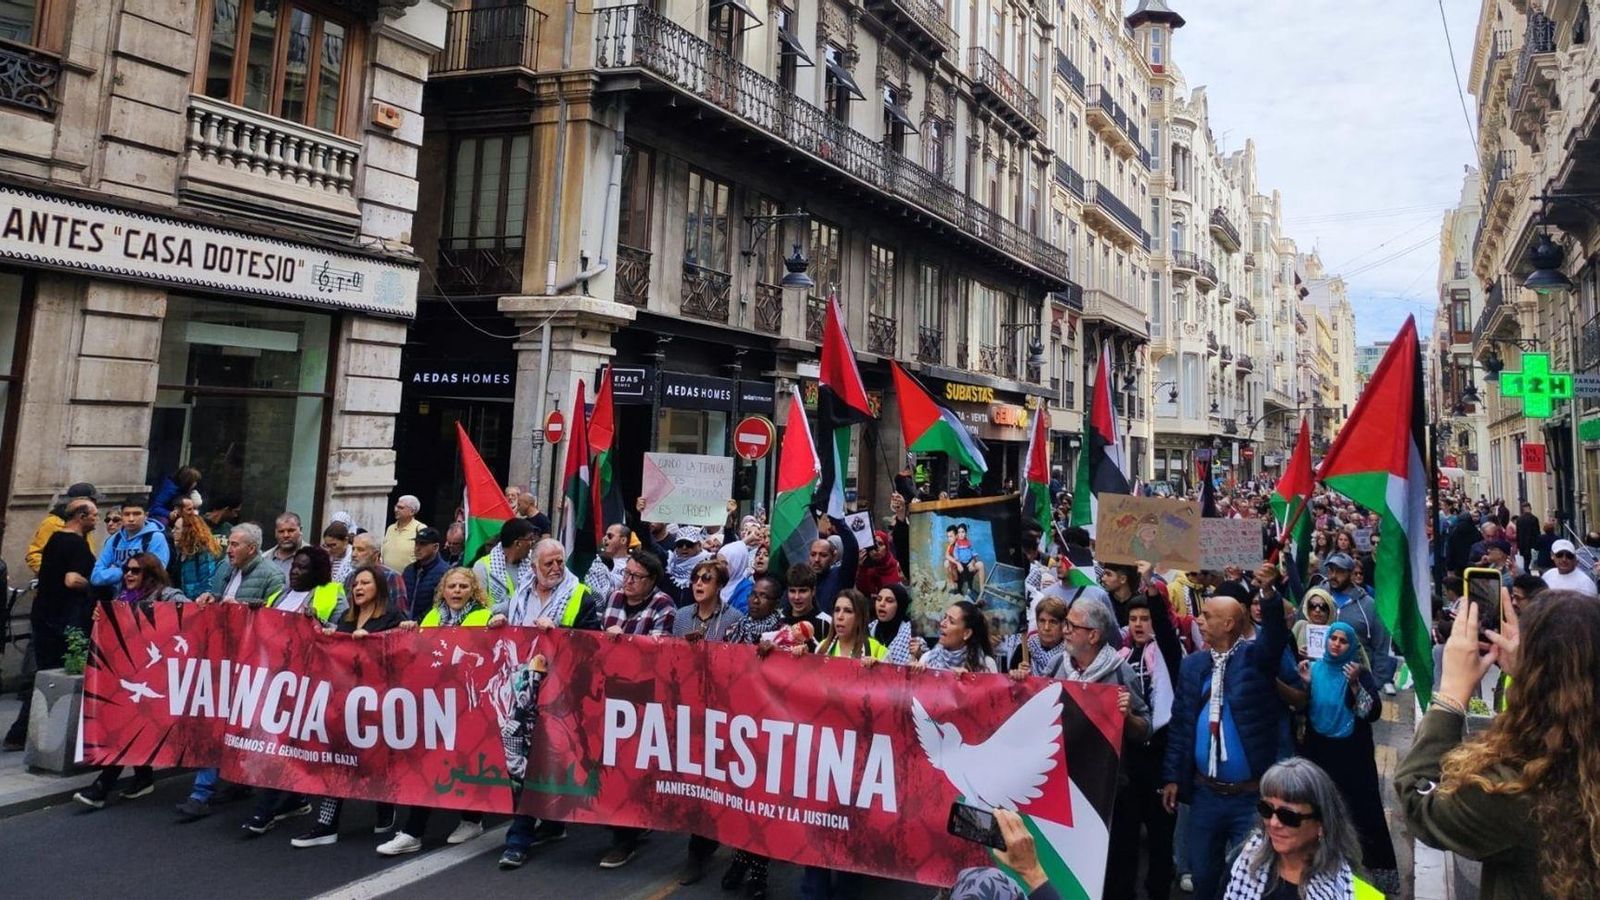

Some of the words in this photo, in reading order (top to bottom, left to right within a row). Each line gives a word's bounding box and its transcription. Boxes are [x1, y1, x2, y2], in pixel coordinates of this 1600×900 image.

[2, 207, 105, 252] ANTES
[114, 226, 193, 268] "CASA
[203, 242, 305, 284] DOTESIO"
[413, 373, 458, 383] AEDAS
[462, 373, 510, 384] HOMES
[614, 375, 639, 383] EDAS
[666, 384, 699, 398] AEDAS
[701, 387, 732, 400] HOMES
[946, 382, 994, 404] SUBASTAS
[971, 412, 988, 423] VENTA
[168, 657, 330, 743] VALNCIA
[345, 685, 457, 751] CON
[602, 697, 898, 814] PALESTINA
[265, 741, 277, 755] EL
[278, 745, 319, 763] GENOCIDIO
[322, 752, 333, 764] EN
[334, 753, 359, 768] GAZA!
[655, 779, 724, 804] MANIFESTACIÓN
[726, 793, 743, 810] POR
[745, 799, 755, 814] LA
[758, 801, 775, 819] PAZ
[778, 806, 784, 819] Y
[787, 807, 800, 823] LA
[802, 810, 850, 831] JUSTICIA
